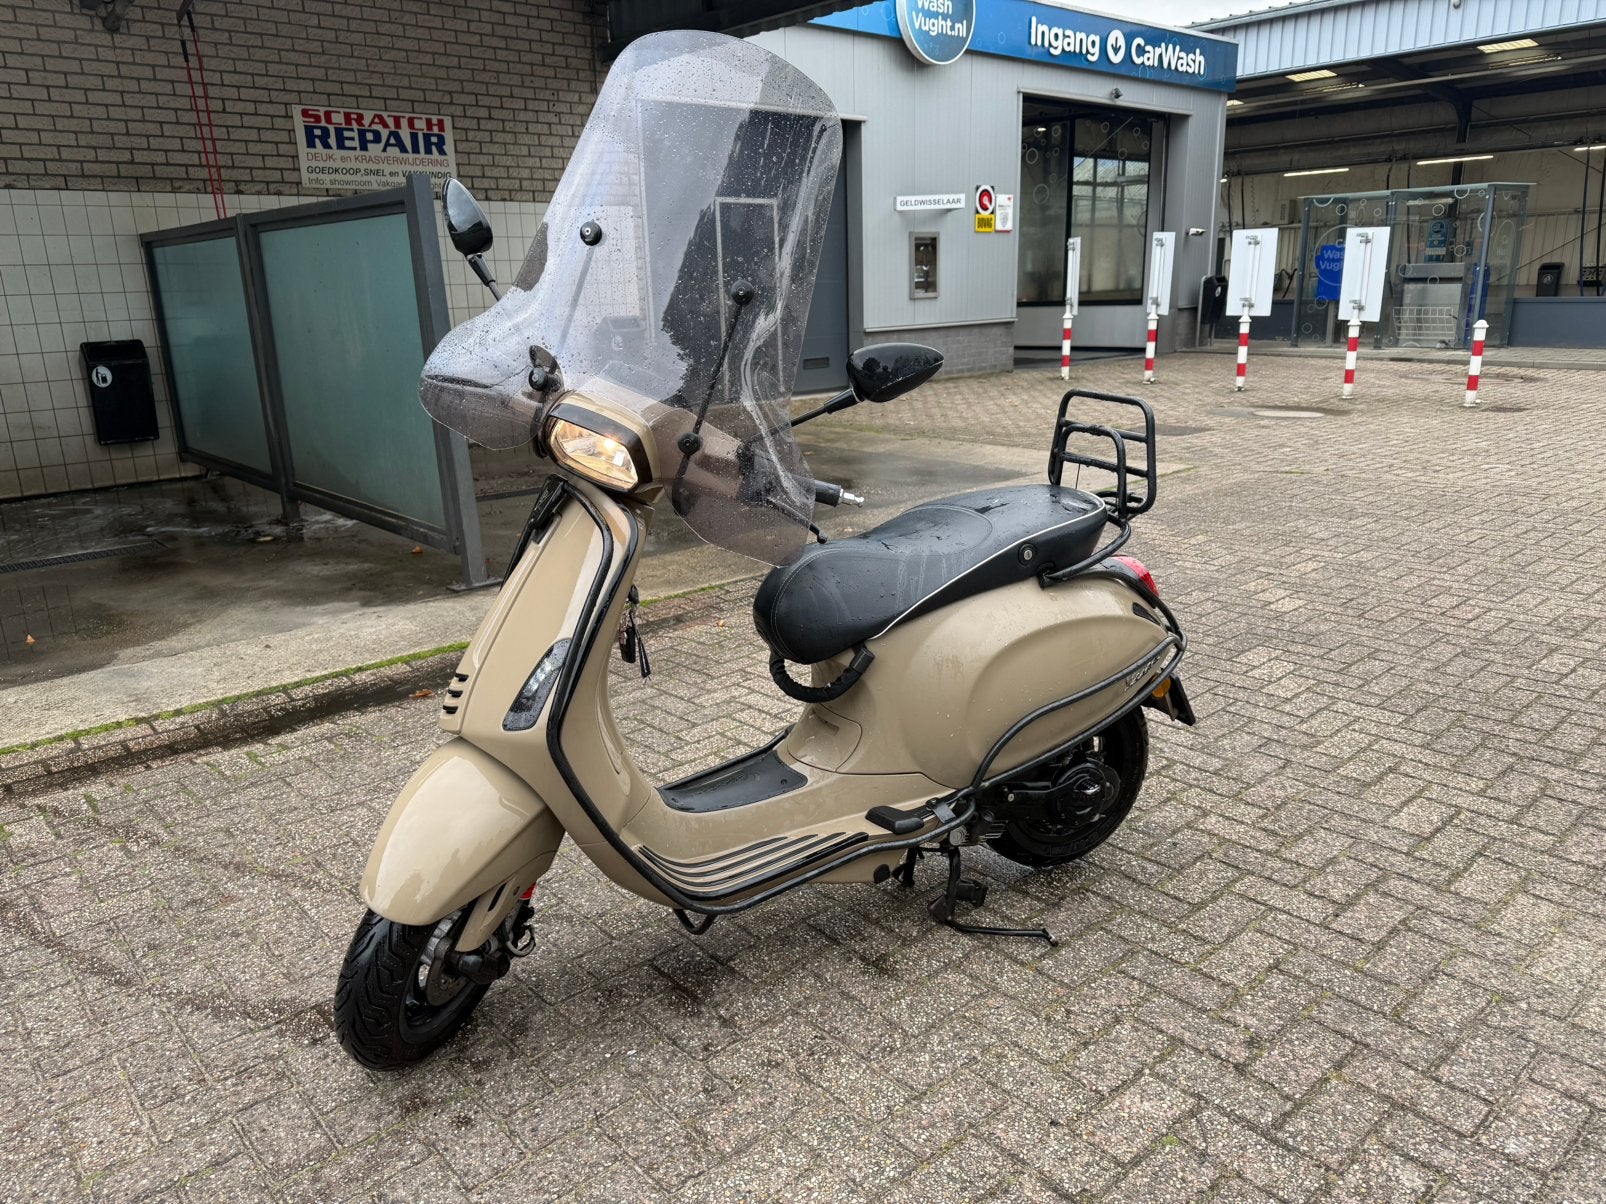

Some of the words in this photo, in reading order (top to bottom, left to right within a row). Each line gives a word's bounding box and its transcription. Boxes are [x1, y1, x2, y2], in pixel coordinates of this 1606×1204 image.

[917, 0, 952, 15] Wash
[912, 11, 967, 37] Vught.nl
[1030, 16, 1100, 62] Ingang
[1131, 37, 1205, 75] CarWash
[301, 108, 445, 133] SCRATCH
[303, 124, 448, 156] REPAIR
[306, 152, 336, 162] DEUK-
[340, 155, 351, 163] en
[354, 154, 450, 168] KRASVERWIJDERING
[306, 165, 387, 178] GOEDKOOP,SNEL
[389, 170, 400, 178] en
[308, 177, 327, 186] Info:
[329, 178, 373, 187] showroom
[900, 198, 962, 207] GELDWISSELAAR
[1323, 249, 1345, 260] Was
